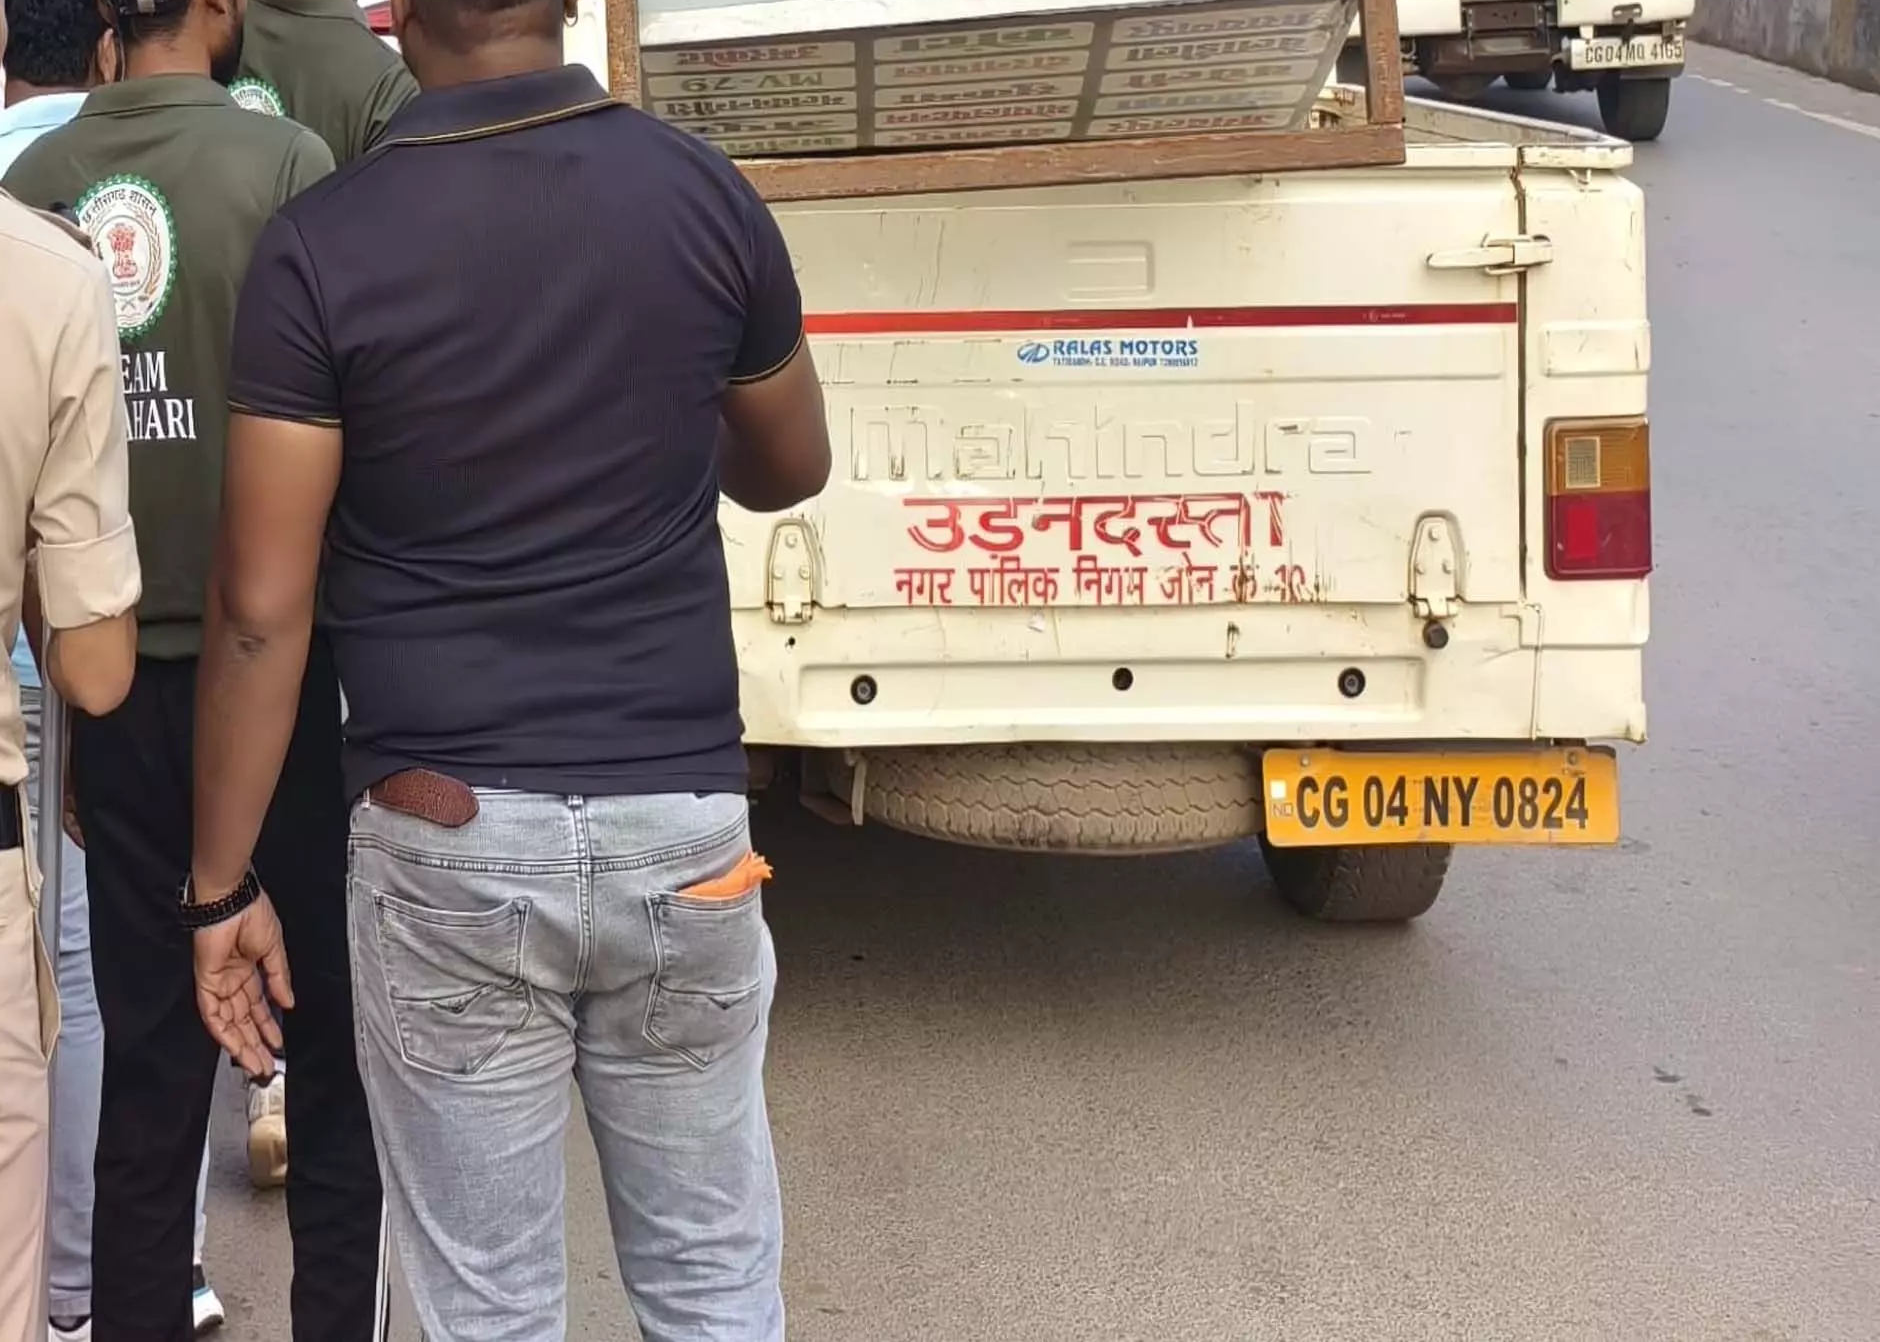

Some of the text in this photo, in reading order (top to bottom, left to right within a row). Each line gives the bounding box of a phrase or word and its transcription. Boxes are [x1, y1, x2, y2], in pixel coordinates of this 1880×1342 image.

[681, 71, 824, 93] MV-79
[1053, 340, 1198, 356] RALAS MOTORS
[122, 351, 168, 393] EAM
[127, 398, 197, 442] AHARI
[894, 566, 956, 606] नगर
[967, 555, 1060, 606] पालिक
[1072, 555, 1149, 606] निगम
[1296, 773, 1590, 829] CG 04 NY 0824
